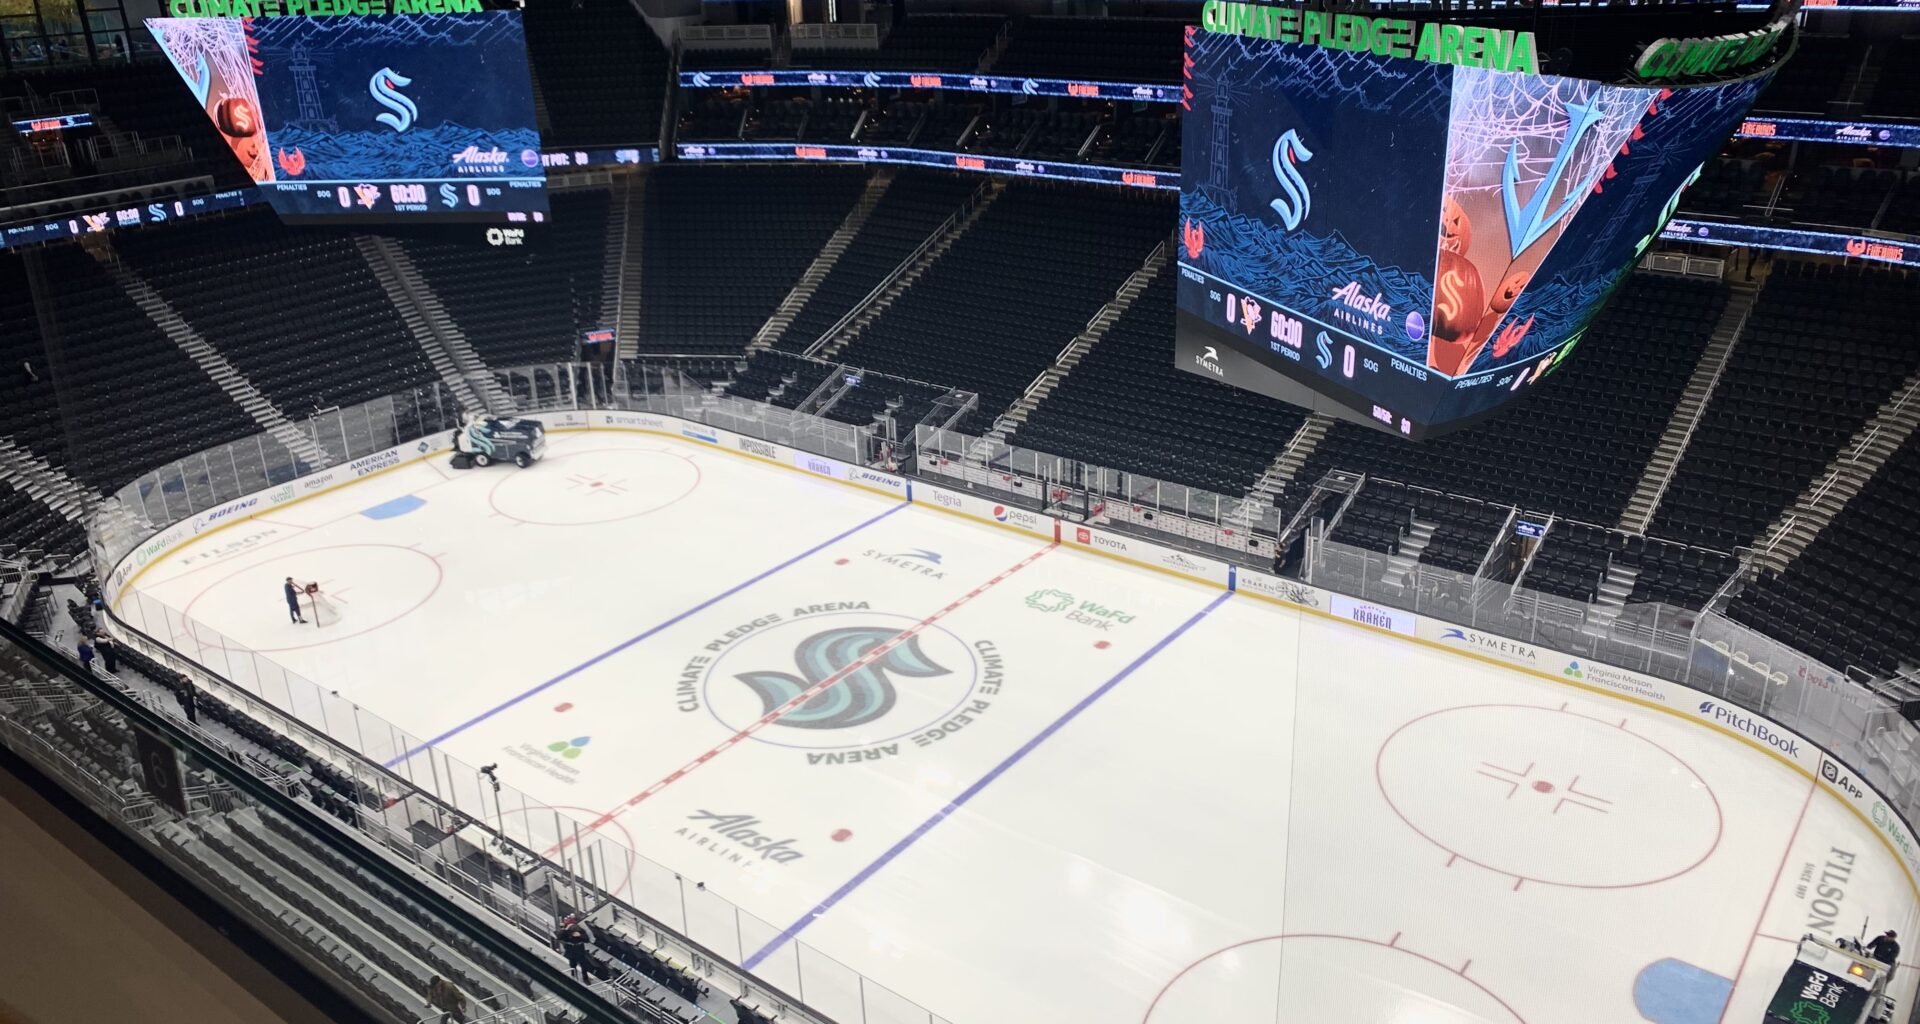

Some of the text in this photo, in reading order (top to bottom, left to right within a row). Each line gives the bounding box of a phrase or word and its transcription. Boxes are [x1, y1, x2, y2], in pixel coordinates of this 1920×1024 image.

[169, 0, 483, 18] CLIMATE PLEDGE ARENA
[1202, 1, 1537, 75] CLIMATE PLEDGE ARENA
[457, 165, 505, 174] AIRLINES
[277, 183, 308, 192] PENALTIES
[317, 190, 331, 198] SOG
[389, 184, 428, 204] 60:00
[466, 184, 481, 207] 0
[509, 181, 542, 189] PENALTIES
[337, 186, 351, 208] 0
[174, 201, 184, 217] 0
[68, 219, 79, 234] 0
[1181, 267, 1205, 285] PENALTIES
[1209, 289, 1221, 302] SOG
[1226, 292, 1236, 323] 0
[1270, 310, 1303, 348] 60:00
[1333, 308, 1383, 335] AIRLINES
[1270, 341, 1301, 362] 1ST PERIOD
[1343, 344, 1356, 378] 0
[1195, 354, 1224, 377] SYMETRA
[1363, 357, 1379, 373] SOG
[1391, 357, 1428, 382] PENALTIES
[1454, 373, 1495, 390] PENALTIES
[350, 449, 398, 471] AMERICAN
[357, 457, 401, 477] EXPRESS
[304, 473, 333, 487] amazon
[861, 472, 901, 488] BOEING
[208, 498, 258, 521] BOEING
[932, 490, 962, 508] Tegria
[1009, 510, 1037, 526] pepsi
[145, 538, 167, 558] WaFd
[181, 528, 278, 566] FILSON
[1094, 535, 1127, 551] TOYOTA
[862, 549, 946, 580] SYMETRA
[1242, 578, 1275, 591] KRAKEN
[1065, 610, 1115, 632] Bank
[1078, 600, 1136, 625] WaFd
[1353, 607, 1392, 630] KRAKEN
[676, 601, 871, 713] CLIMATE PLEDGE ARENA
[1469, 633, 1536, 660] SYMETRA
[1587, 673, 1666, 701] Franciscan Health
[1588, 664, 1653, 689] Virginia Mason
[806, 639, 1006, 766] CLIMATE PLEDGE ARENA
[1715, 706, 1799, 758] PitchBook
[686, 809, 805, 863] Alaska
[674, 827, 753, 868] AIRLINE
[1806, 846, 1858, 937] FILSON
[1800, 970, 1829, 1000] WaFd
[1819, 982, 1849, 1008] Bank
